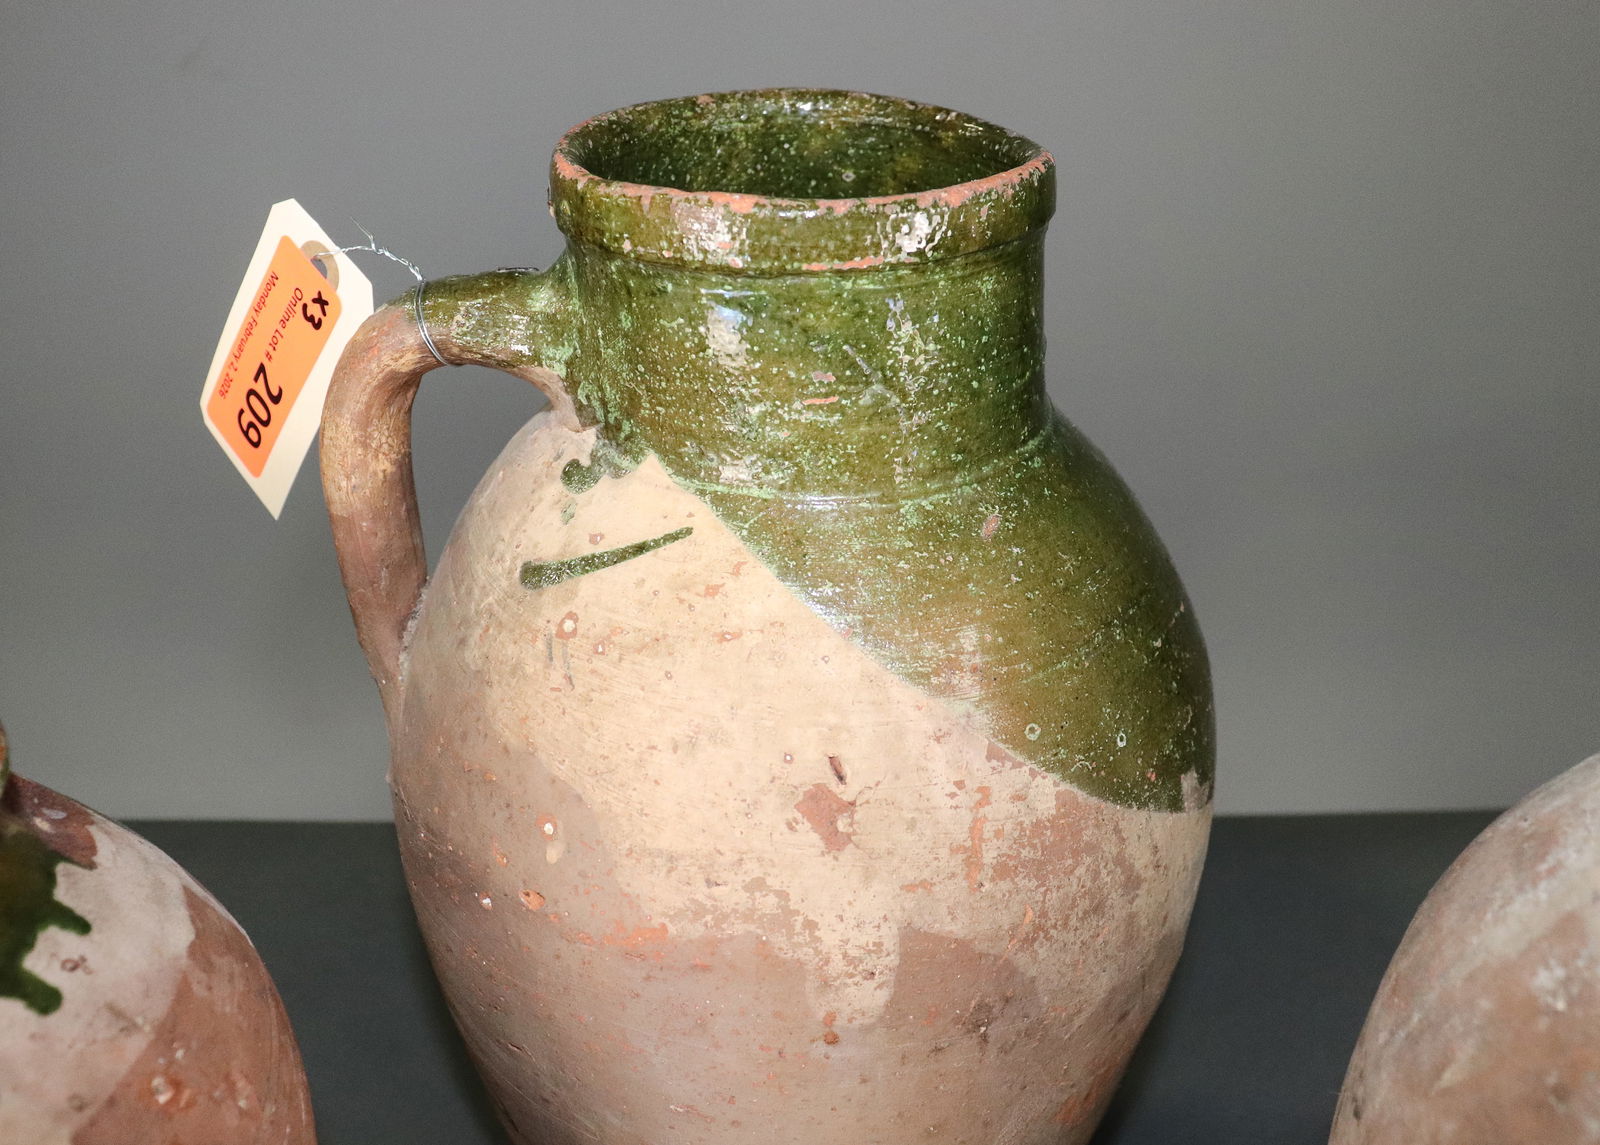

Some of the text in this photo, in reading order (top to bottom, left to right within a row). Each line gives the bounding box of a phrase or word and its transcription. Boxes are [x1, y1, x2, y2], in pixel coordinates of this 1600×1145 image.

[219, 271, 279, 399] Monday February 2, 2026
[237, 287, 303, 449] Online Lot # 209
